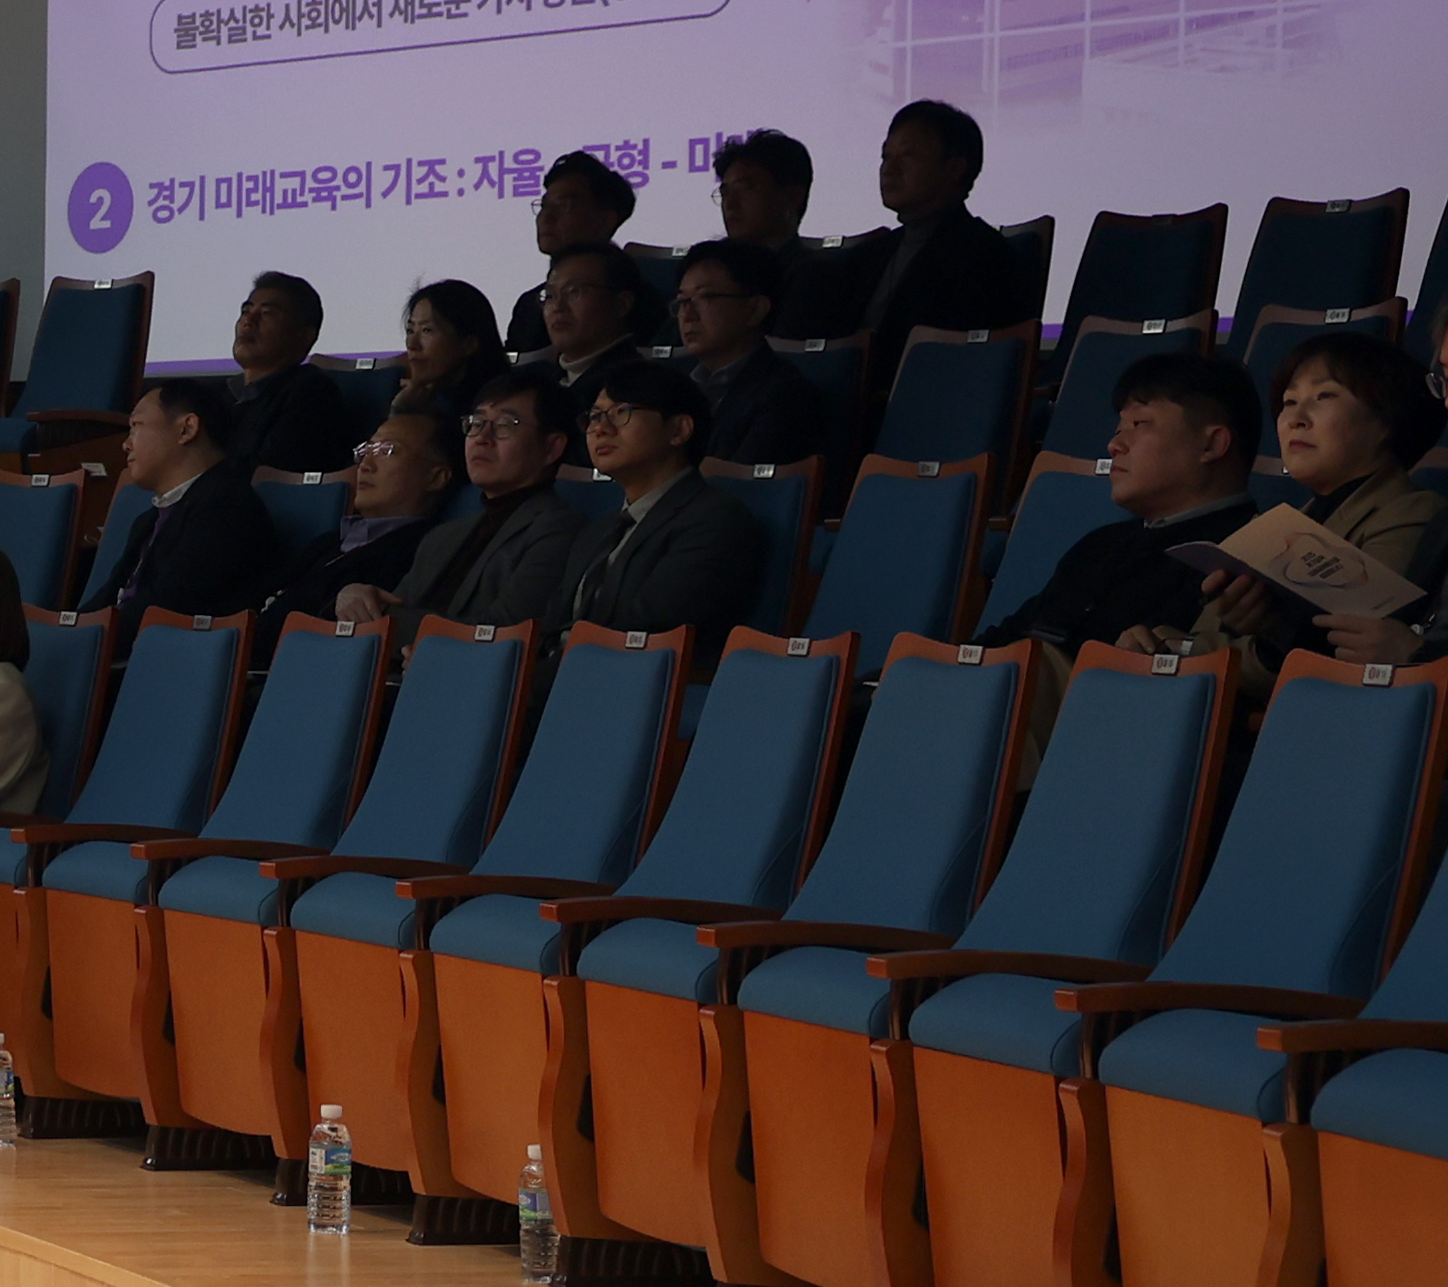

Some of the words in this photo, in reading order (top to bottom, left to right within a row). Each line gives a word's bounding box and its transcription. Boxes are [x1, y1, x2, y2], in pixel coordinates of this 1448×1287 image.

[173, 1, 273, 51] 불확실한
[89, 187, 112, 230] 2
[148, 174, 206, 225] 경기
[213, 157, 375, 217] 미래교육의
[382, 152, 447, 199] 기조
[473, 148, 545, 199] 자율
